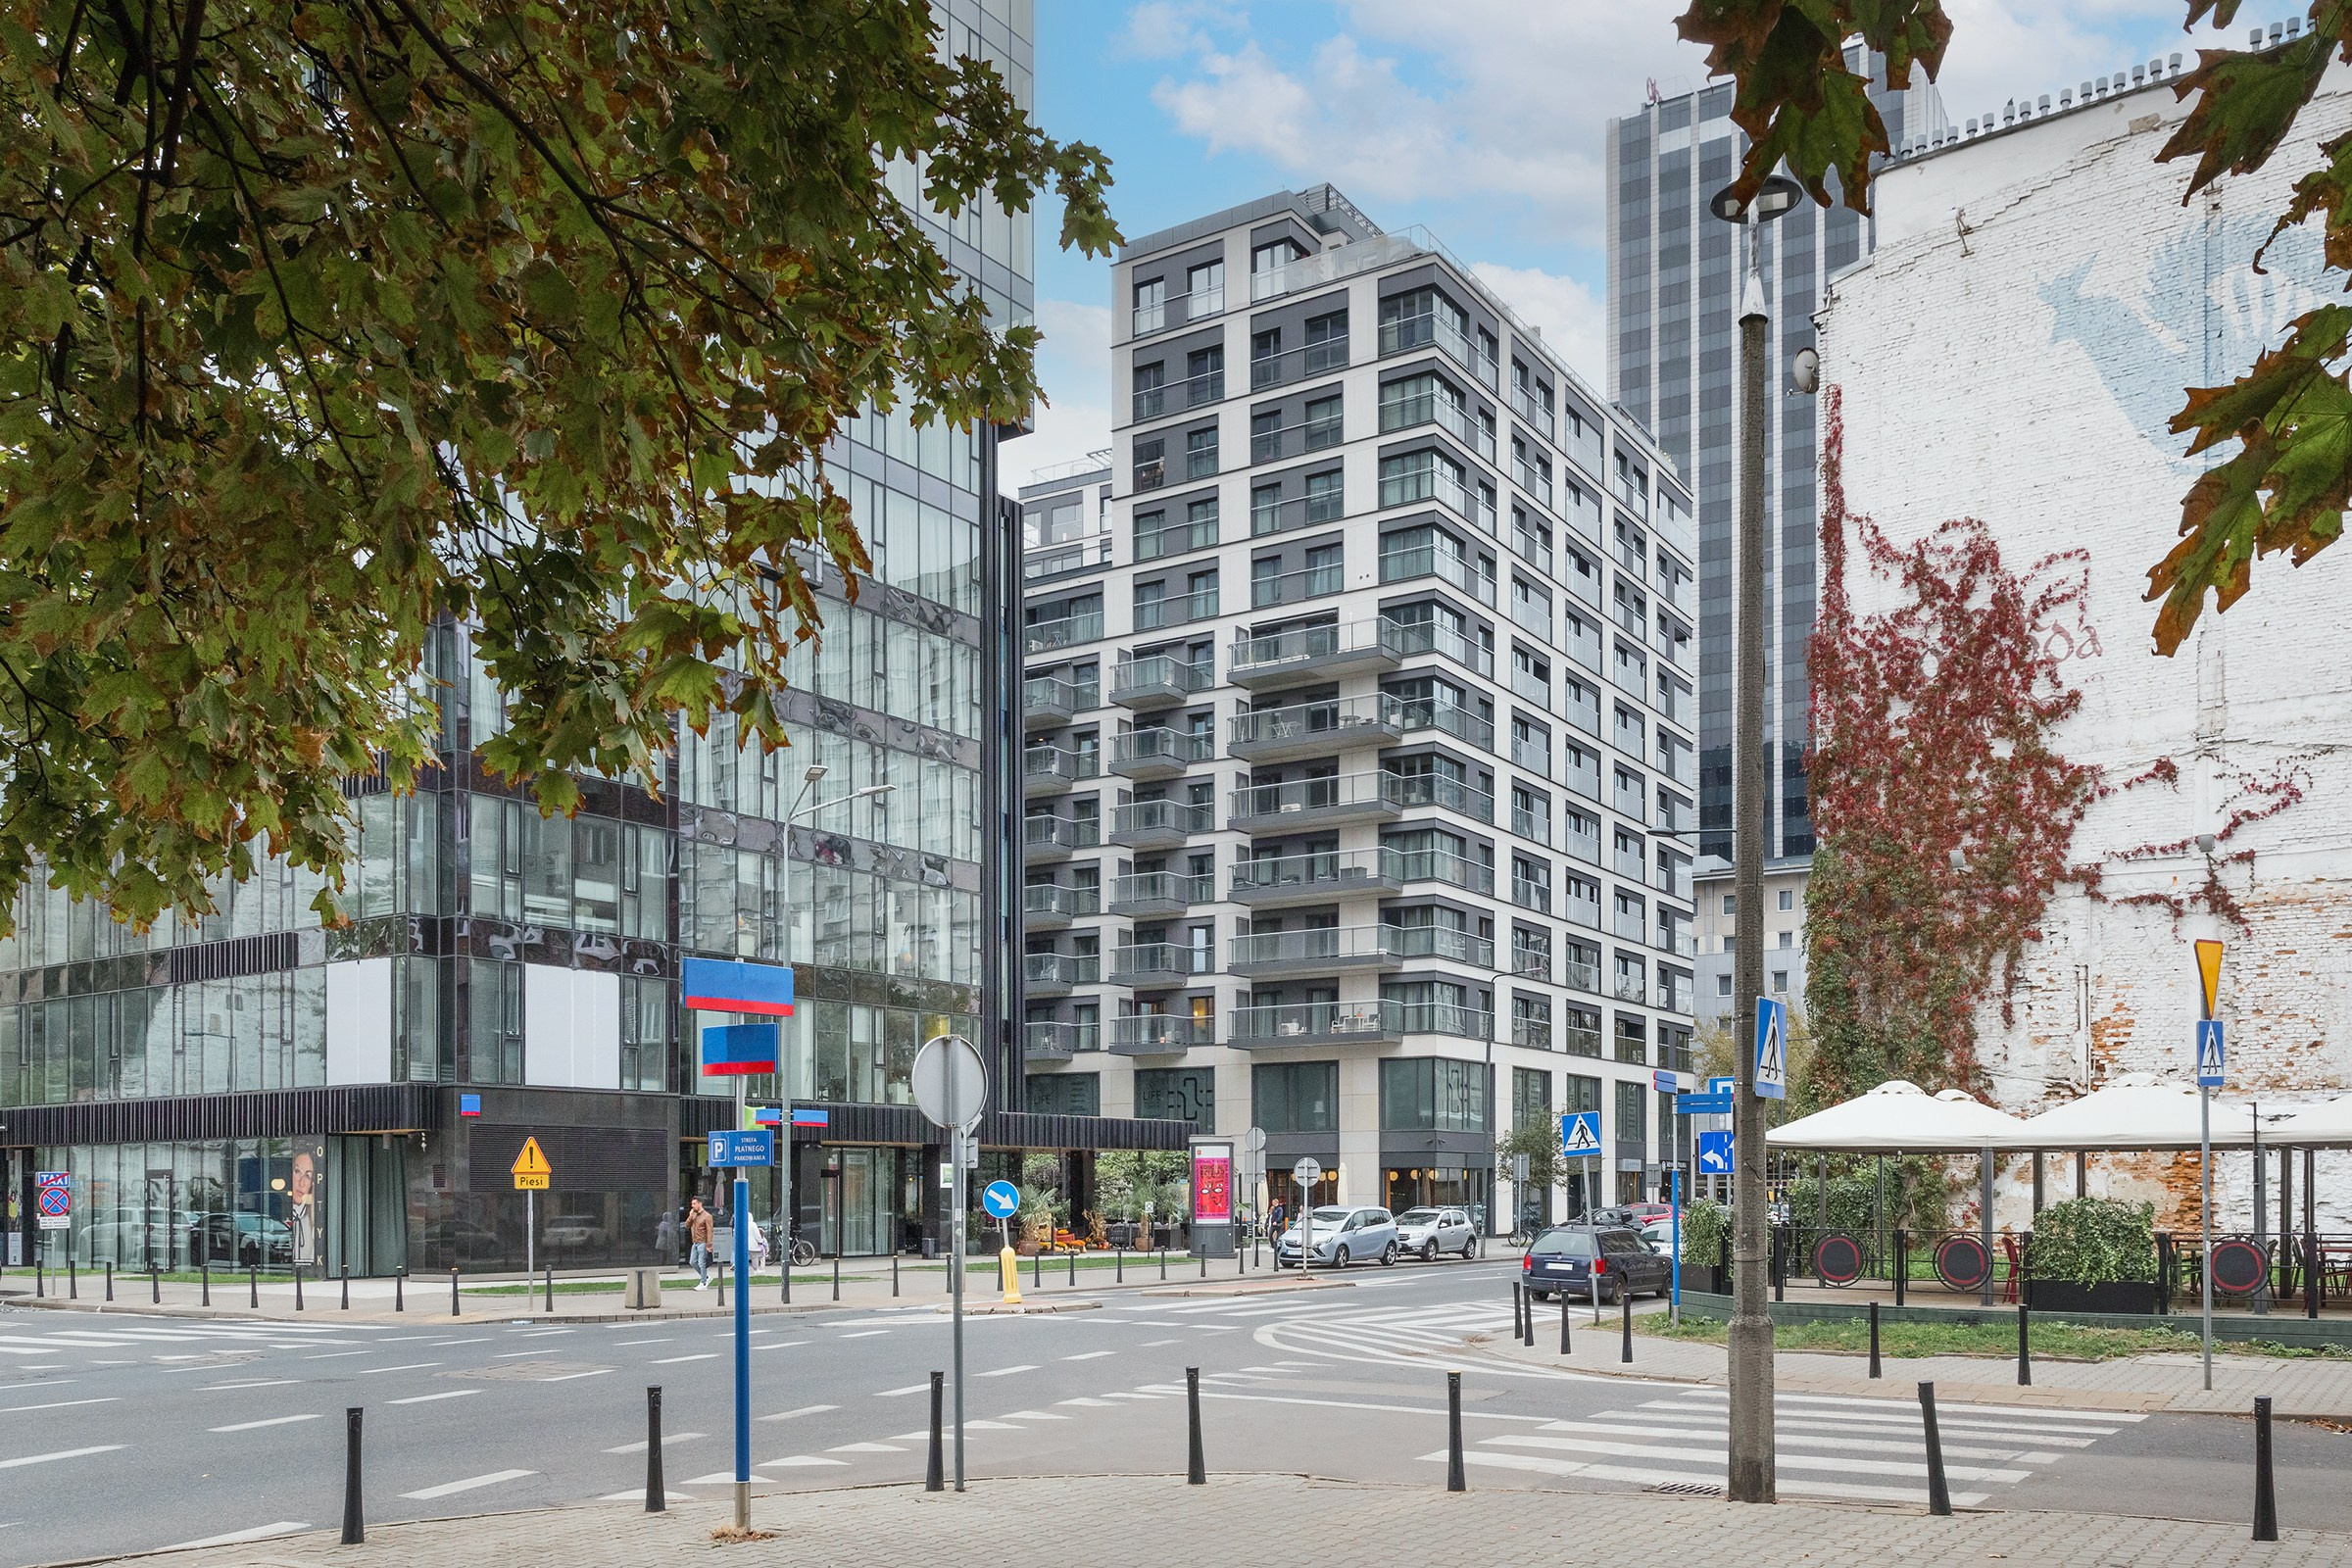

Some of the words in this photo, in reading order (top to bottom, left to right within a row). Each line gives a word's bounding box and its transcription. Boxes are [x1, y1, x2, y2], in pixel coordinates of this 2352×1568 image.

[714, 1142, 723, 1158] P
[41, 1174, 68, 1186] TAXI
[519, 1176, 543, 1186] Piesi
[316, 1146, 324, 1266] OPTYK
